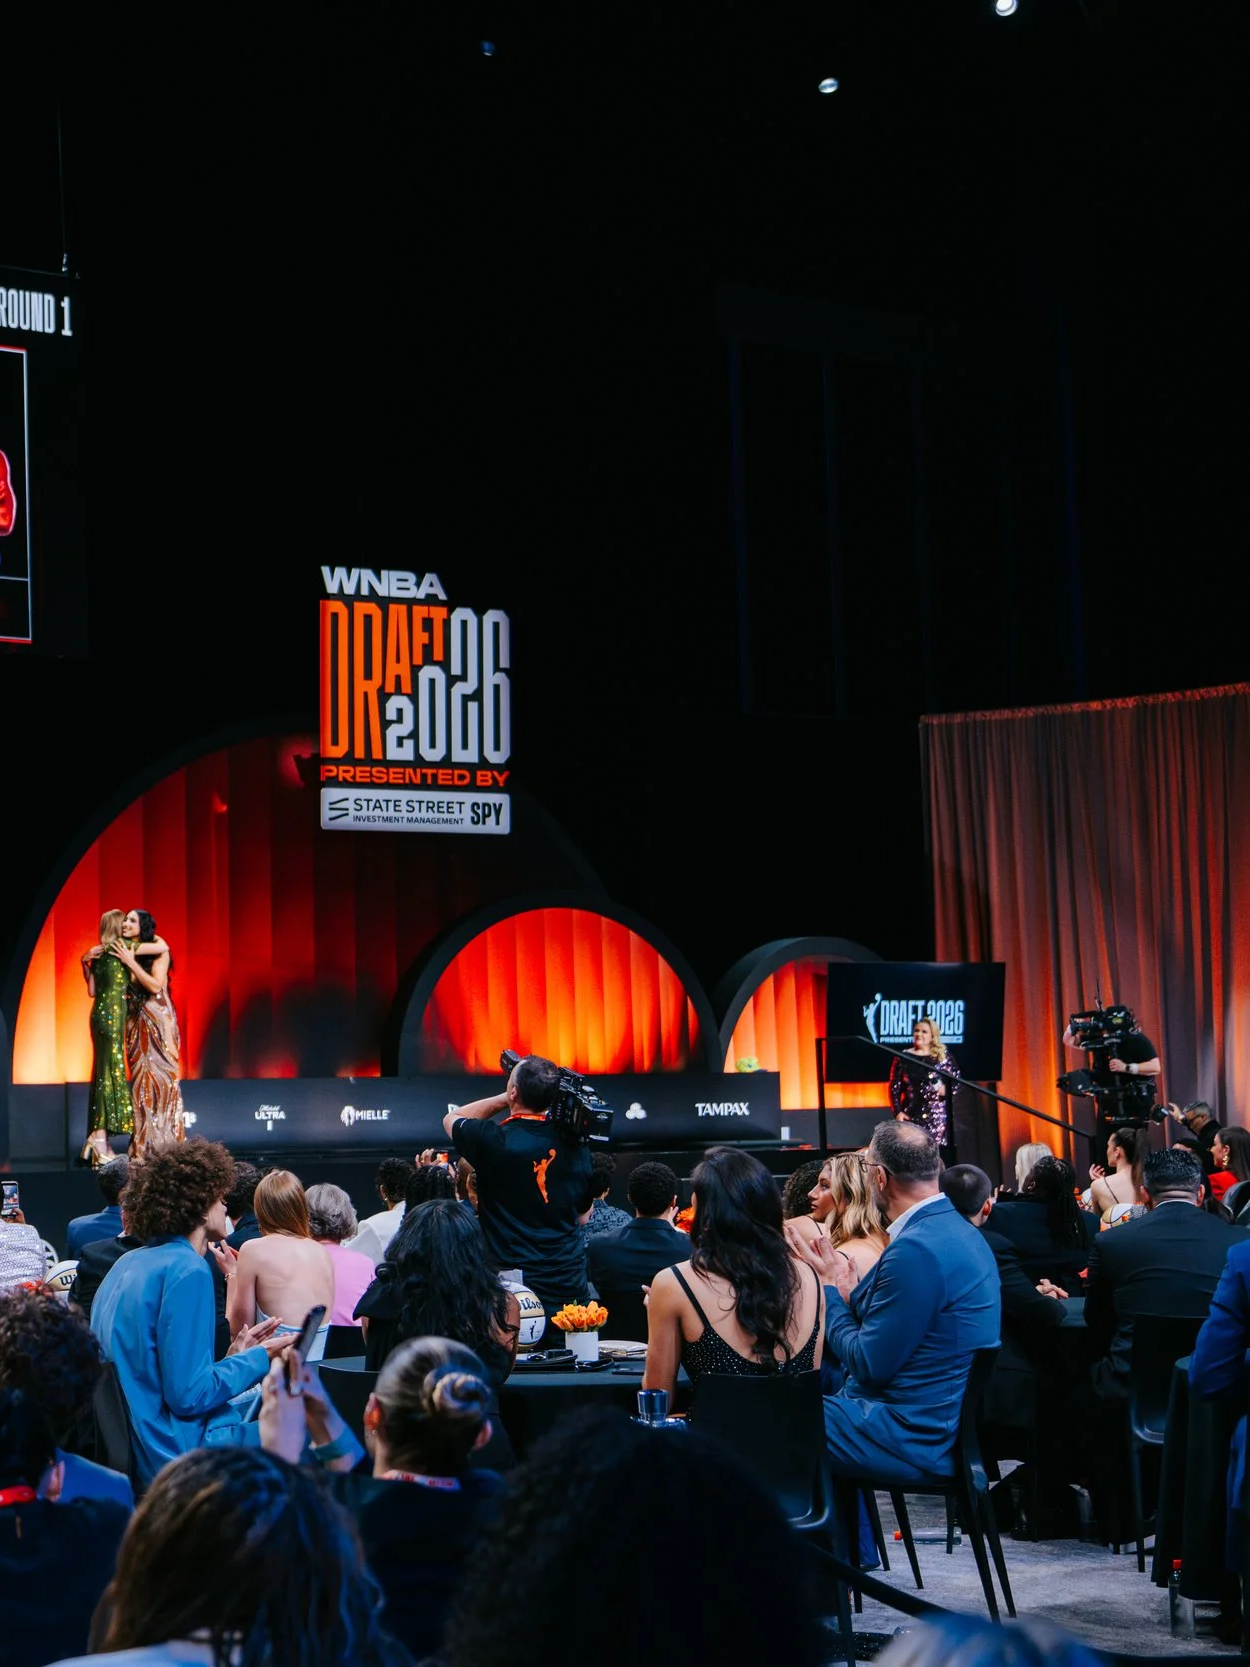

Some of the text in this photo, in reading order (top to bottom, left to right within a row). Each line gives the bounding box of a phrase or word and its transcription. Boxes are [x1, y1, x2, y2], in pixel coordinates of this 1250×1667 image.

[61, 296, 73, 337] 1
[320, 565, 448, 601] WNBA
[319, 599, 448, 761] DRAFT
[384, 606, 511, 765] 2026
[320, 765, 510, 787] PRESENTED BY
[353, 797, 466, 815] STATE STREET
[470, 801, 503, 826] SPY
[353, 813, 465, 826] INVESTMENT MANAGEMENT
[880, 1000, 926, 1035] DRAFT
[254, 1111, 286, 1120] ULTRA
[355, 1110, 390, 1120] MIELLE
[695, 1101, 750, 1117] TAMPAX
